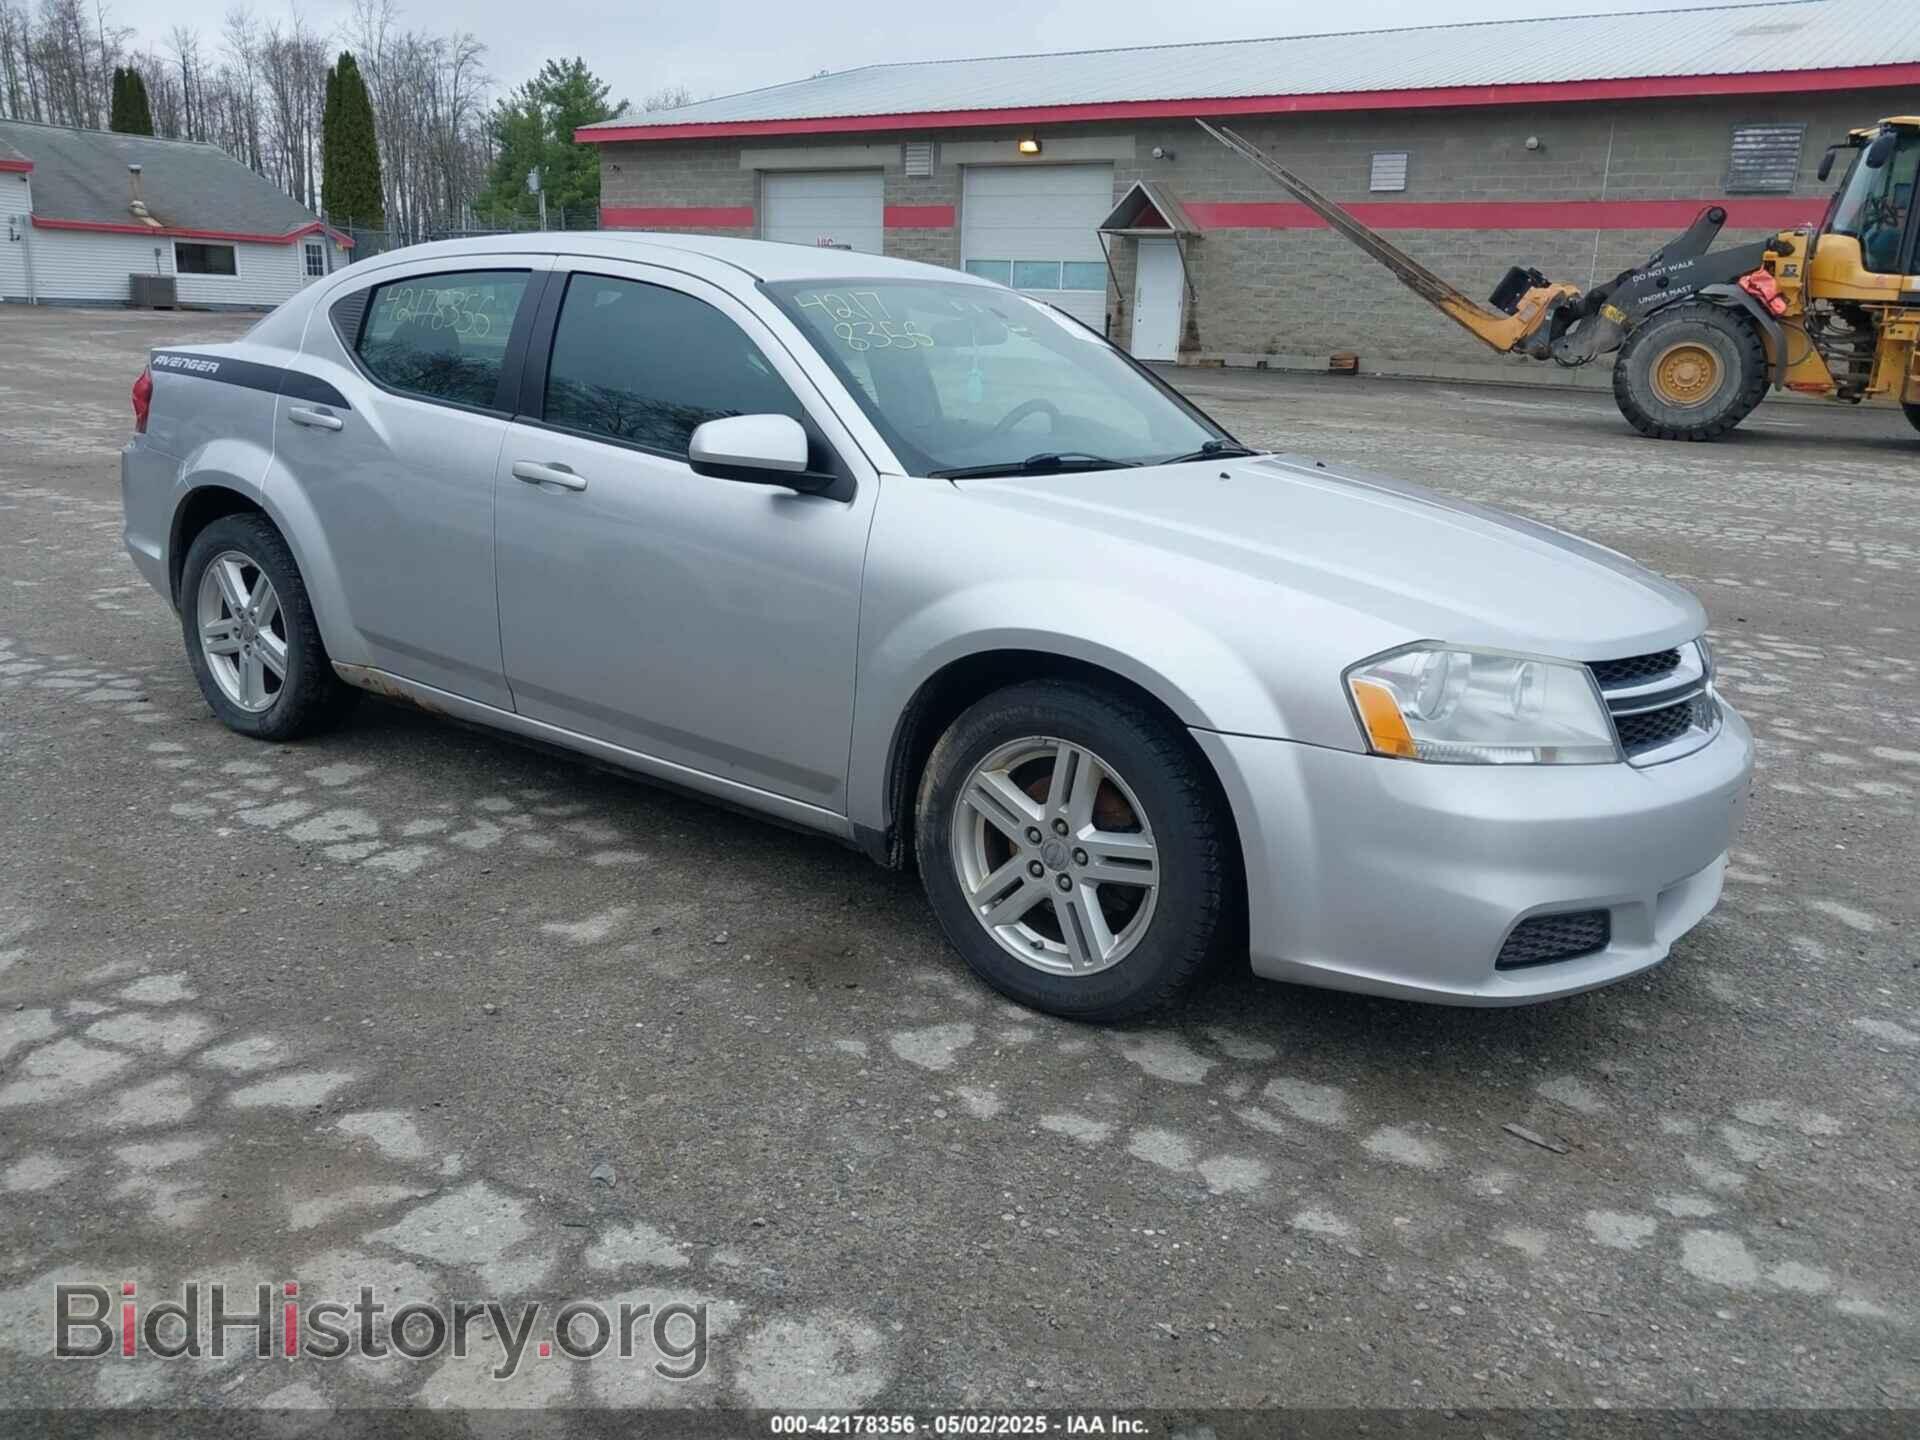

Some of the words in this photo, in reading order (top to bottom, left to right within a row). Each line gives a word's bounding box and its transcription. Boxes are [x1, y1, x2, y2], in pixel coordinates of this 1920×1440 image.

[1632, 273, 1646, 283] DO
[1647, 267, 1667, 278] NOT
[1669, 260, 1695, 272] WALK
[1638, 291, 1668, 304] UNDER
[1669, 284, 1693, 296] MAST
[386, 287, 495, 338] 42178356
[793, 292, 891, 322] 4217
[153, 354, 220, 374] AVENGER
